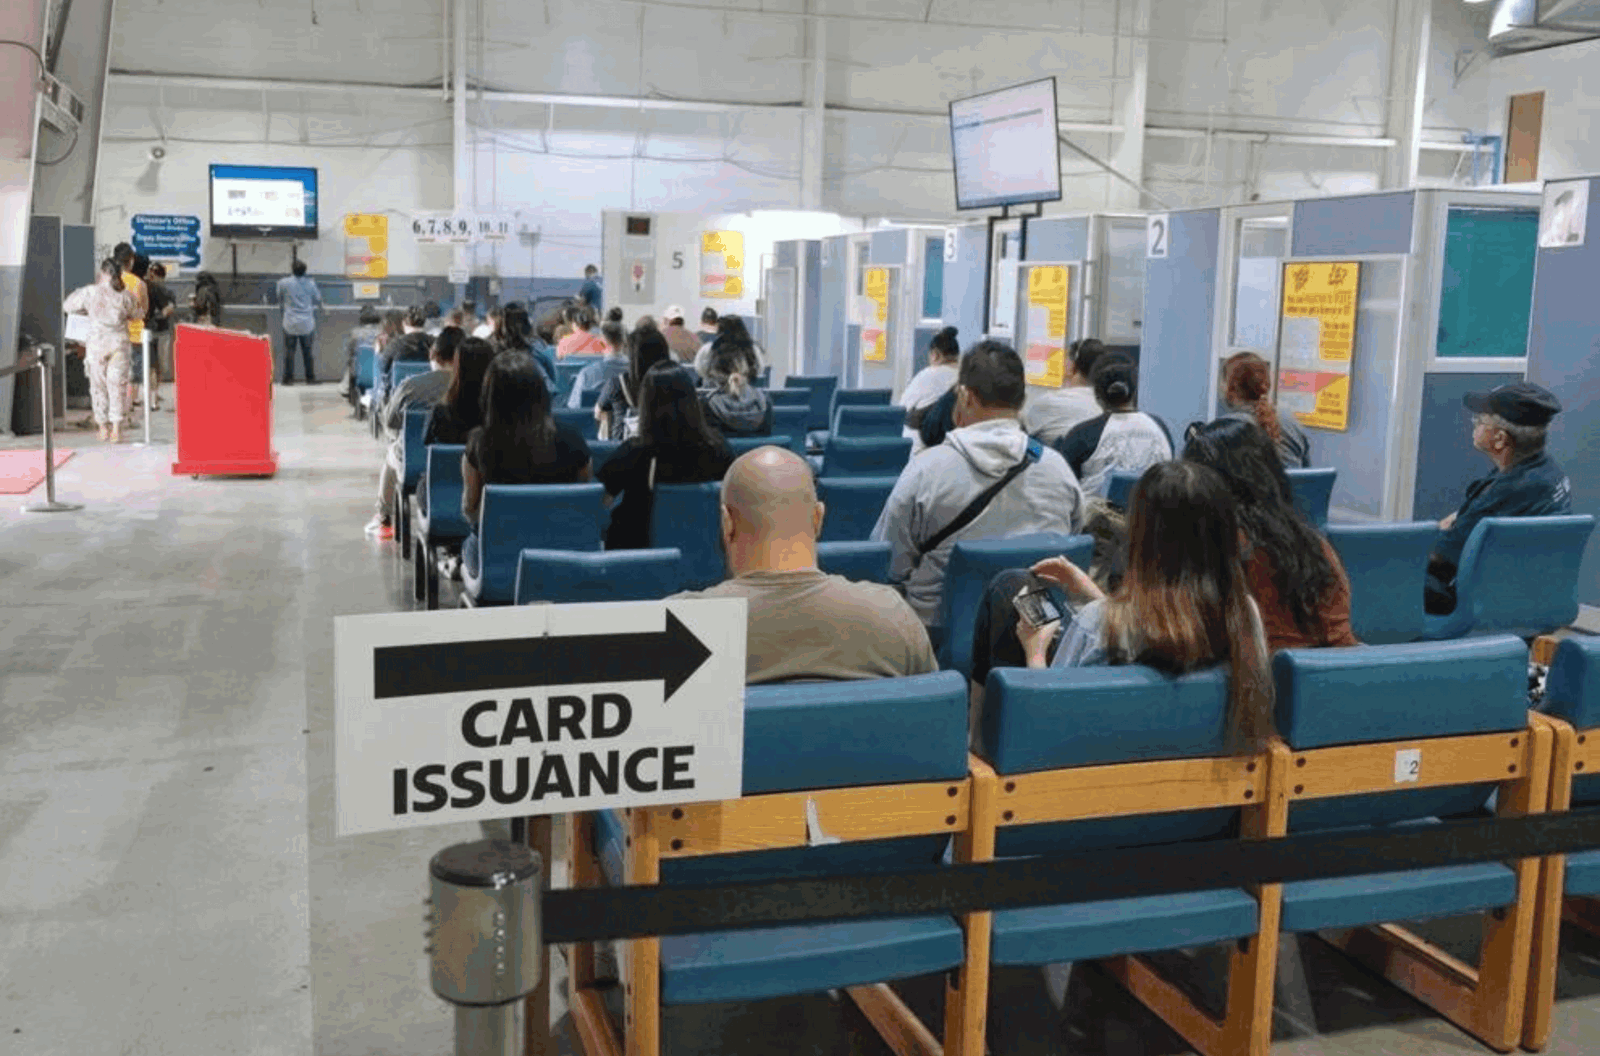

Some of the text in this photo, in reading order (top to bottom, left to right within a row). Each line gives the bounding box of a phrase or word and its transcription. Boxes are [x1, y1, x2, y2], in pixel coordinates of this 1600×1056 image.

[947, 232, 956, 260] 3
[1151, 219, 1165, 256] 2
[672, 251, 684, 270] 5
[461, 692, 633, 749] CARD
[393, 745, 696, 816] ISSUANCE
